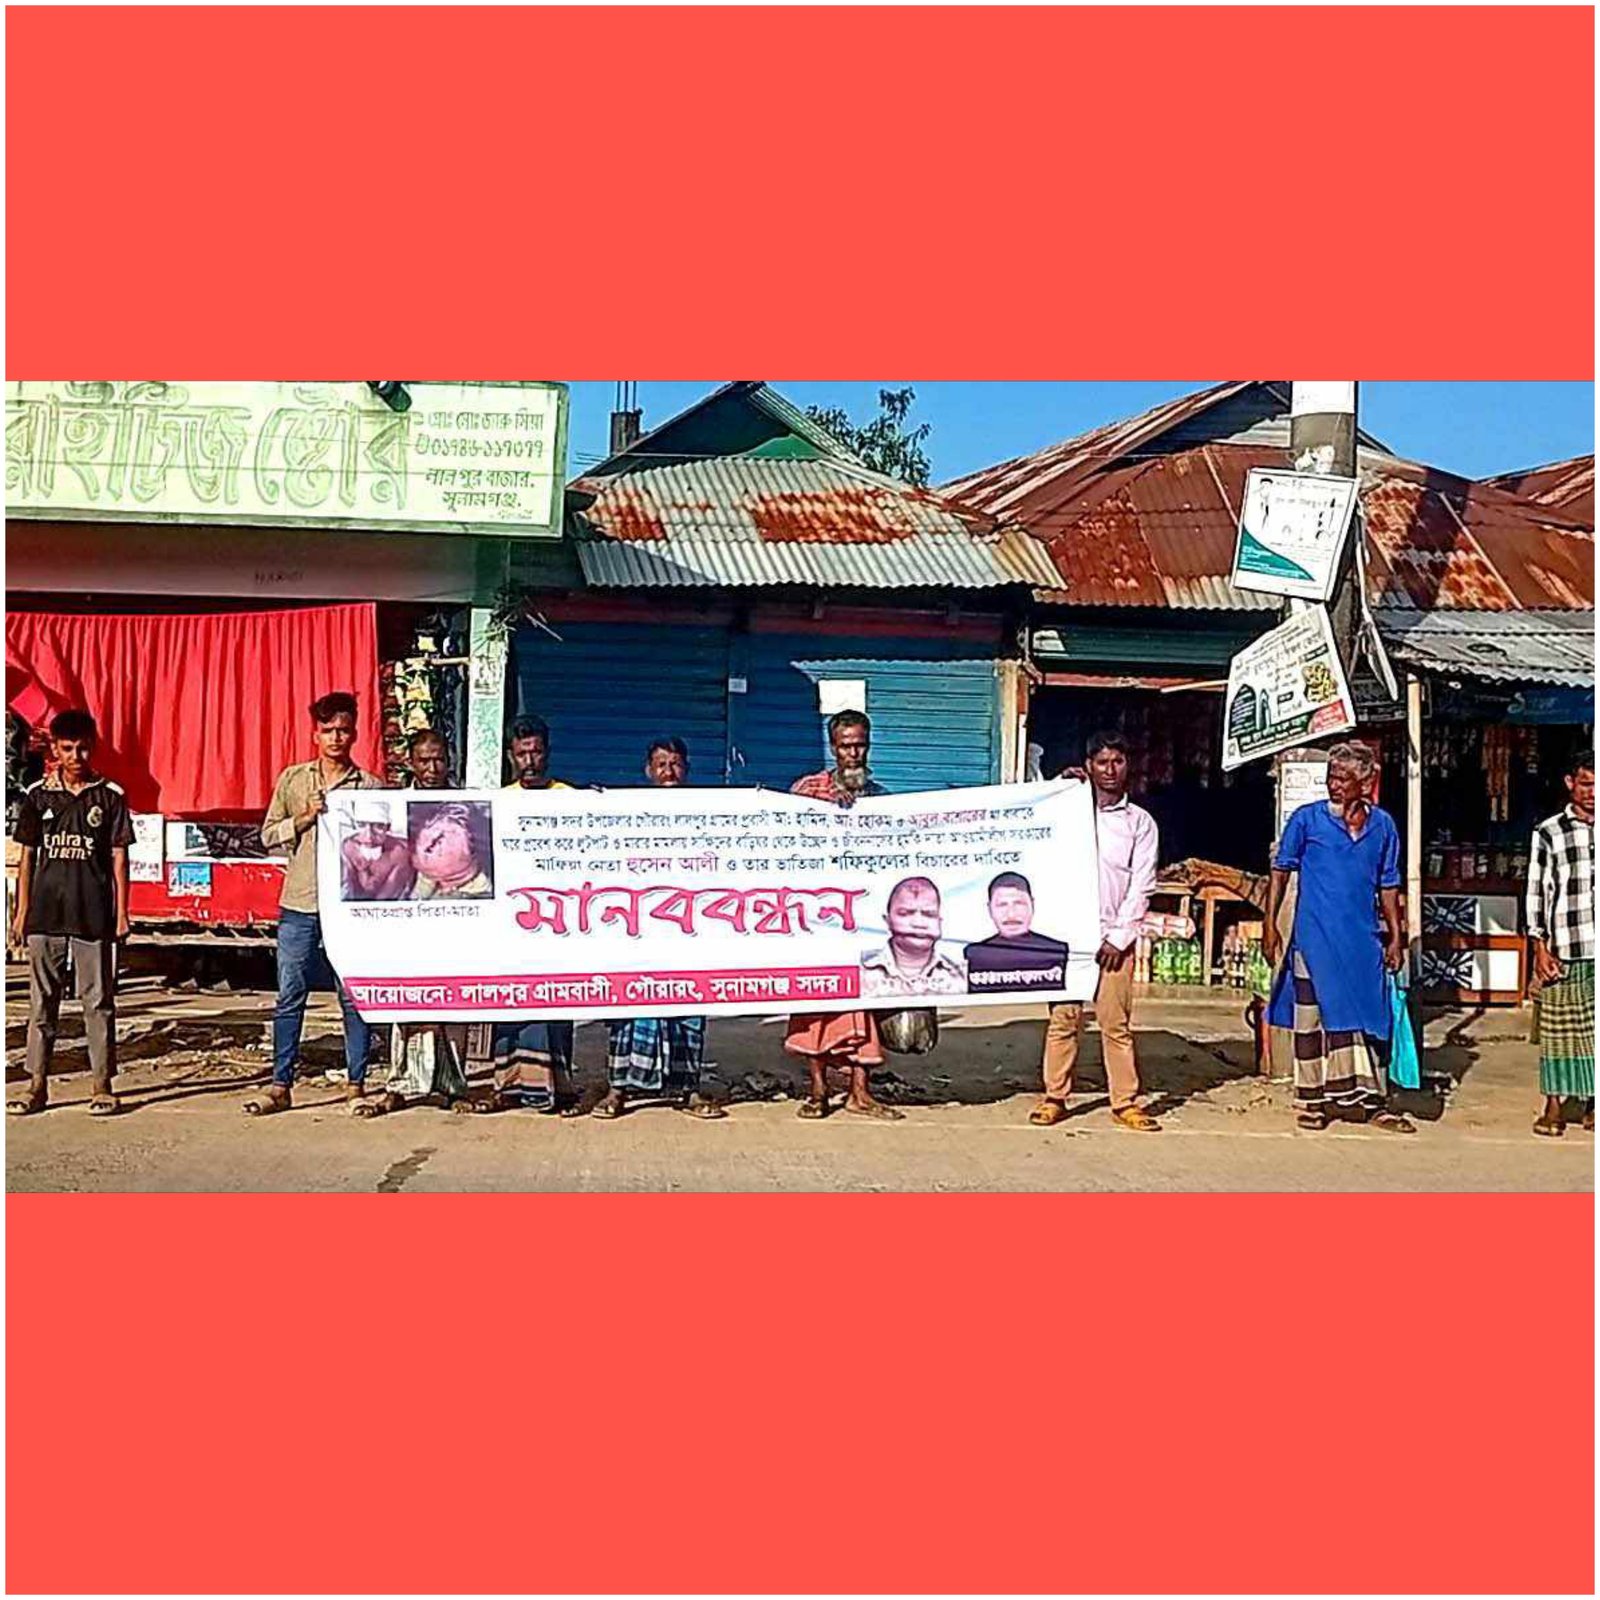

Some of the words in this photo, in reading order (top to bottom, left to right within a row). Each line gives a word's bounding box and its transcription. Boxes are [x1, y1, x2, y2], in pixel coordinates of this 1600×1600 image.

[587, 859, 622, 872] নেতা
[626, 857, 673, 876] হুসেন
[678, 851, 720, 873] আলী
[726, 858, 738, 871] ও
[743, 858, 770, 871] তার
[775, 853, 825, 871] ভাতিজা
[829, 850, 910, 874] শফিকুলের
[915, 851, 969, 868] বিচারের
[506, 881, 870, 939] মানববন্ধন
[459, 982, 530, 1007] লালপুর
[532, 974, 618, 1004] গ্রামবাসী,
[625, 975, 704, 1001] গৌরারং,
[710, 975, 791, 1002] সুনামগঞ্জ
